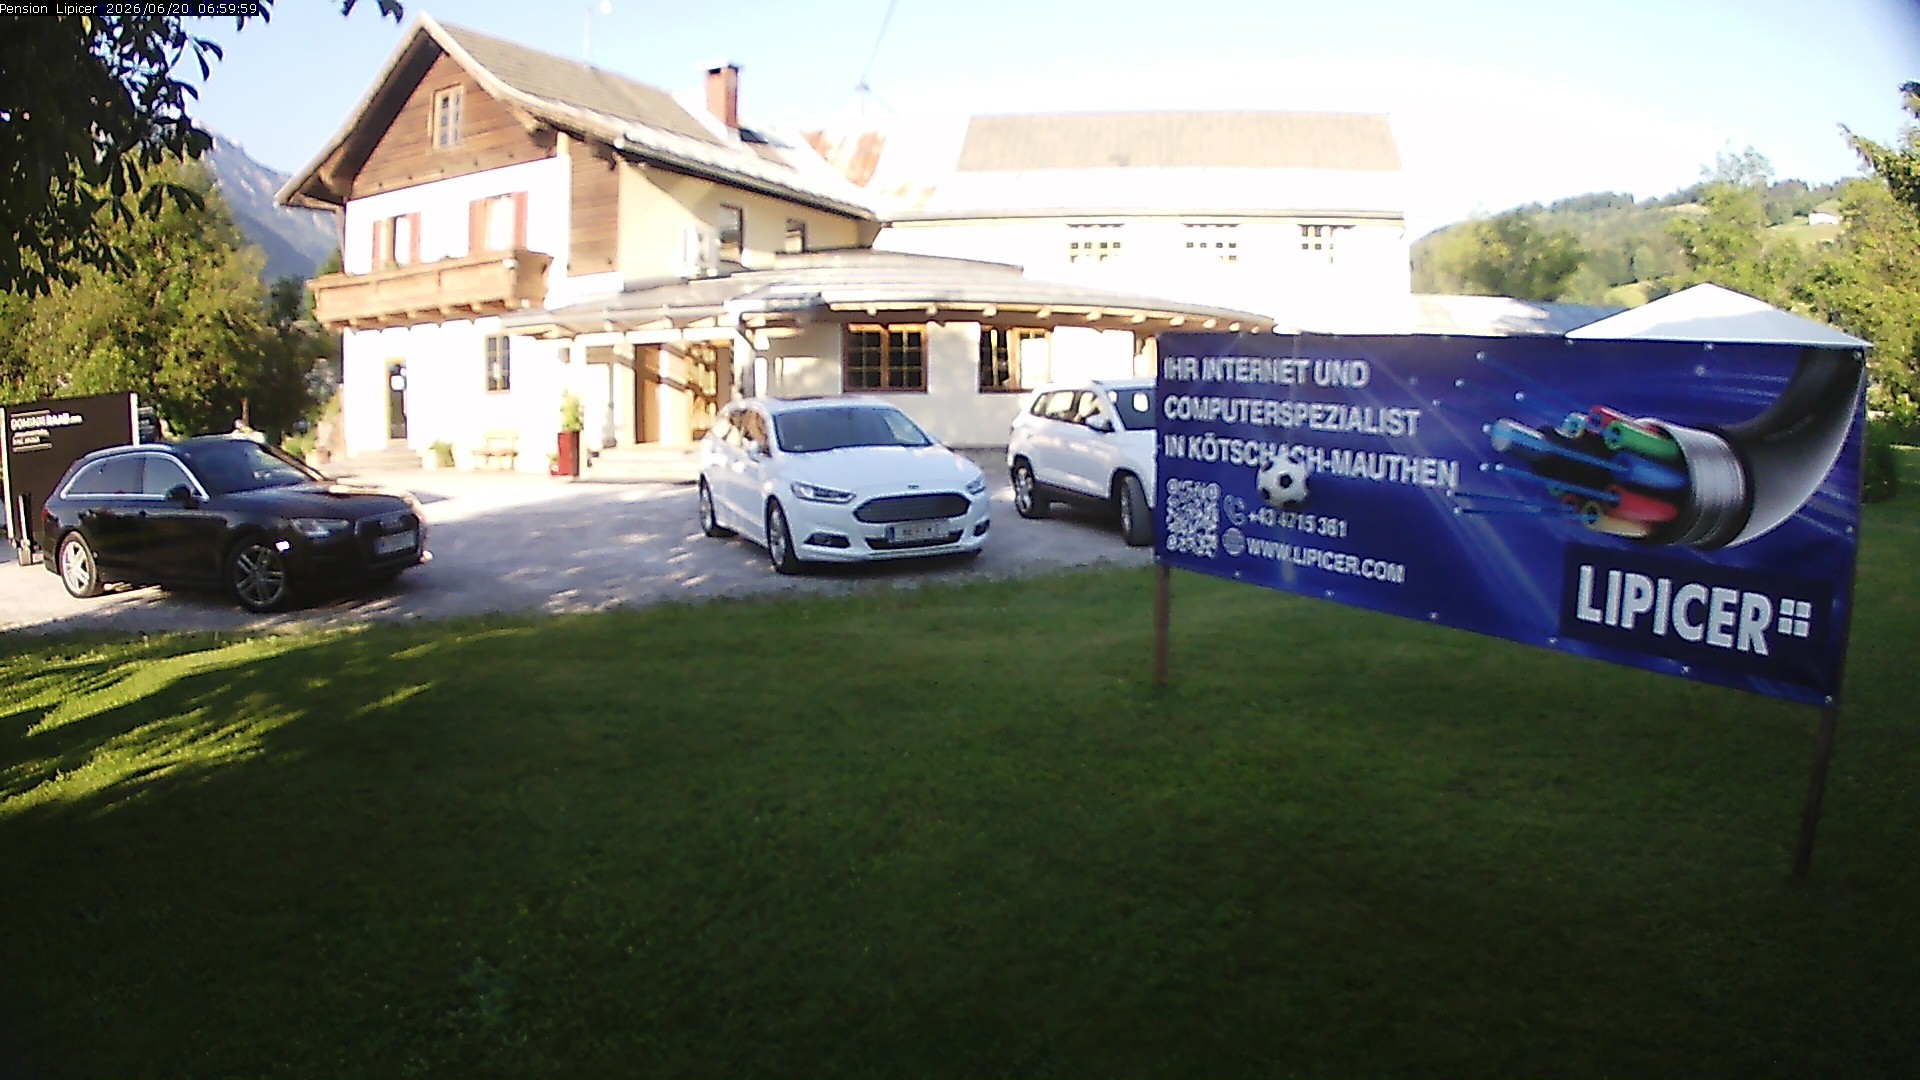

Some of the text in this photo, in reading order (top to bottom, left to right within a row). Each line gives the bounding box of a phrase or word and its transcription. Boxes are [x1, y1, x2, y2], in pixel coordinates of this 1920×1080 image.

[1163, 356, 1371, 388] IHR INTERNET UND
[1163, 394, 1421, 438] COMPUTERSPEZIALIST
[1163, 434, 1186, 459] IN
[1248, 506, 1276, 528] +43
[1317, 516, 1348, 539] 361
[1246, 536, 1407, 584] WWW.LIPICER.COM
[1576, 564, 1773, 656] LIPICER
